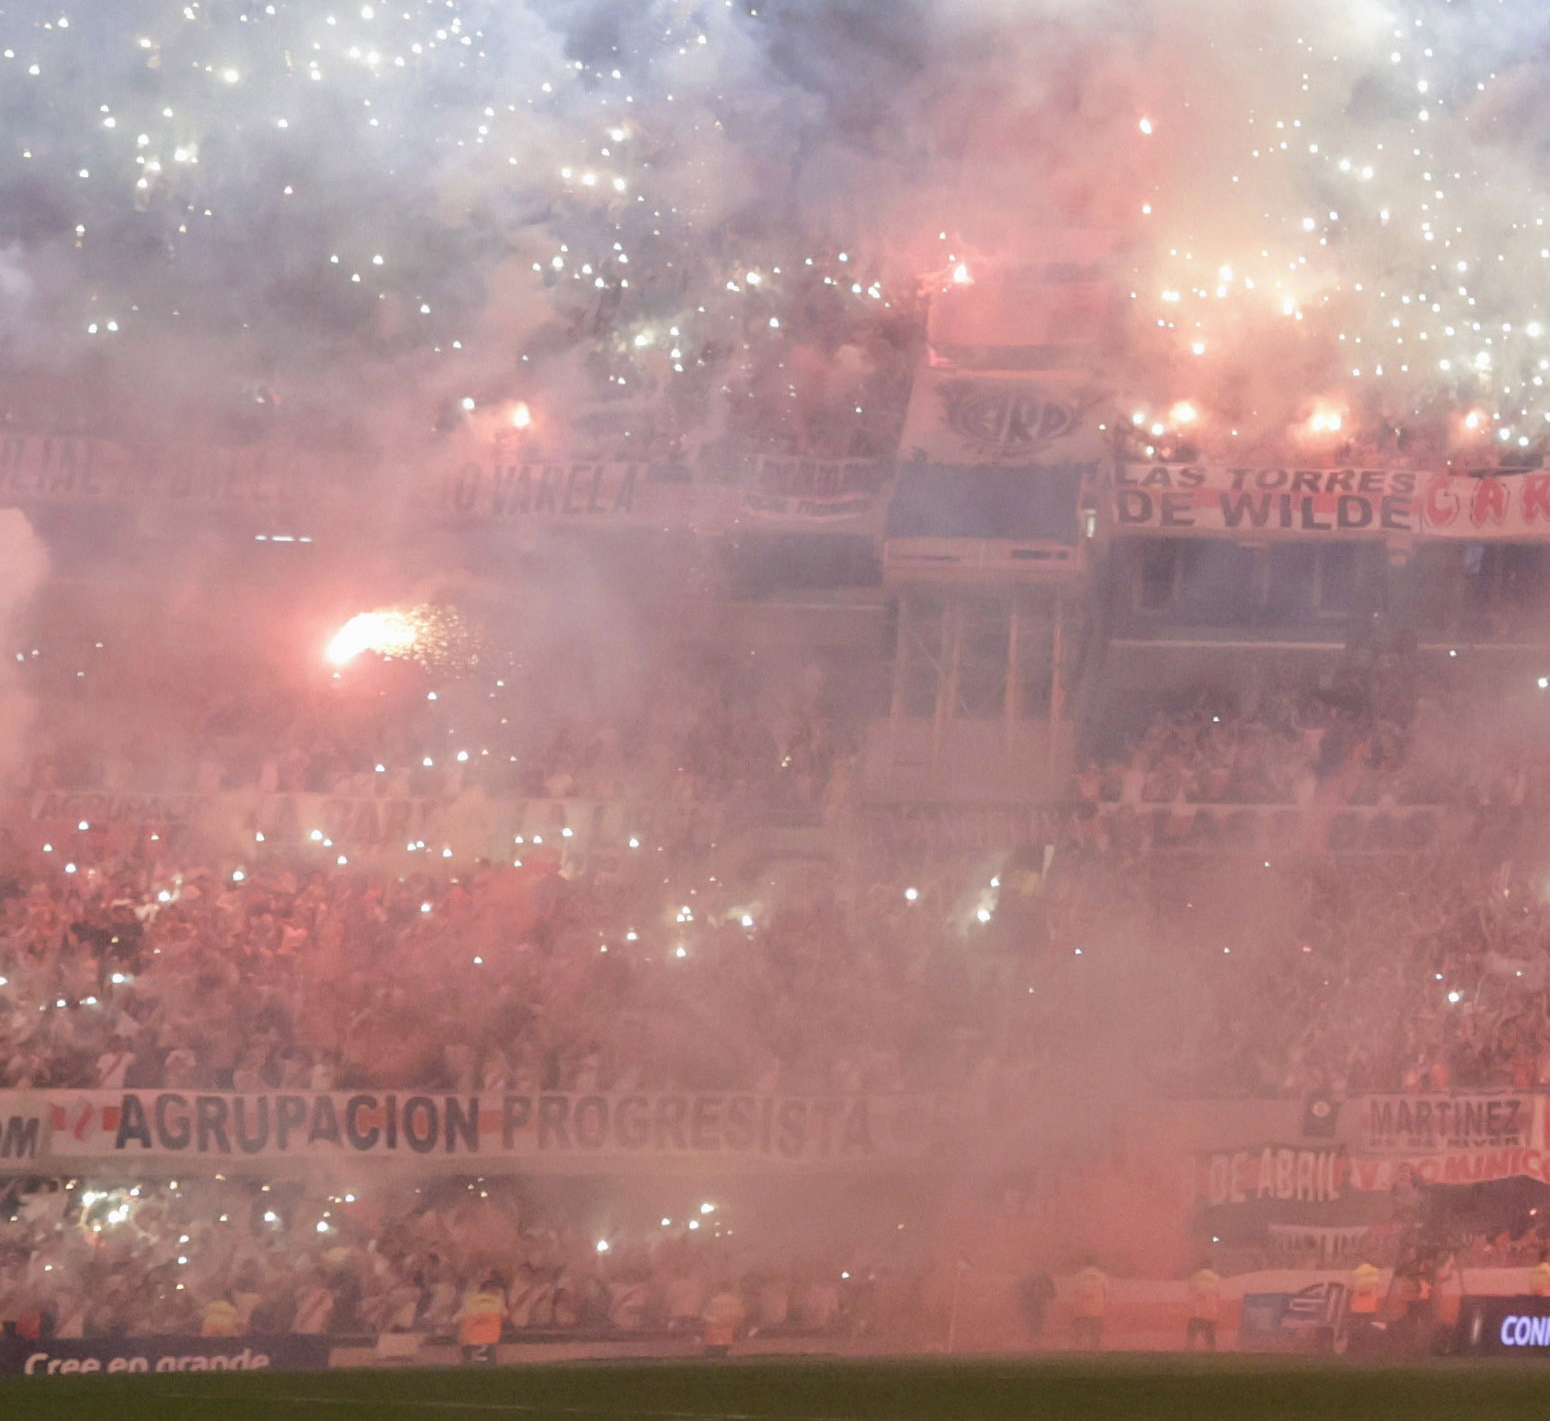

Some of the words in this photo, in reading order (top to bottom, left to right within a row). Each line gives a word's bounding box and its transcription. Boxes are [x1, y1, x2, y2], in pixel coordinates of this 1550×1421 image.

[493, 463, 638, 515] VARELA
[1114, 465, 1206, 490] LAS
[1228, 466, 1417, 494] TORRES
[1117, 489, 1197, 528] DE
[1220, 491, 1415, 531] WILDE
[115, 1092, 482, 1154] AGRUPACION
[501, 1092, 875, 1158] PROGRESISTA
[1370, 1099, 1522, 1137] MARTINEZ
[1255, 1145, 1341, 1203] ABRIL
